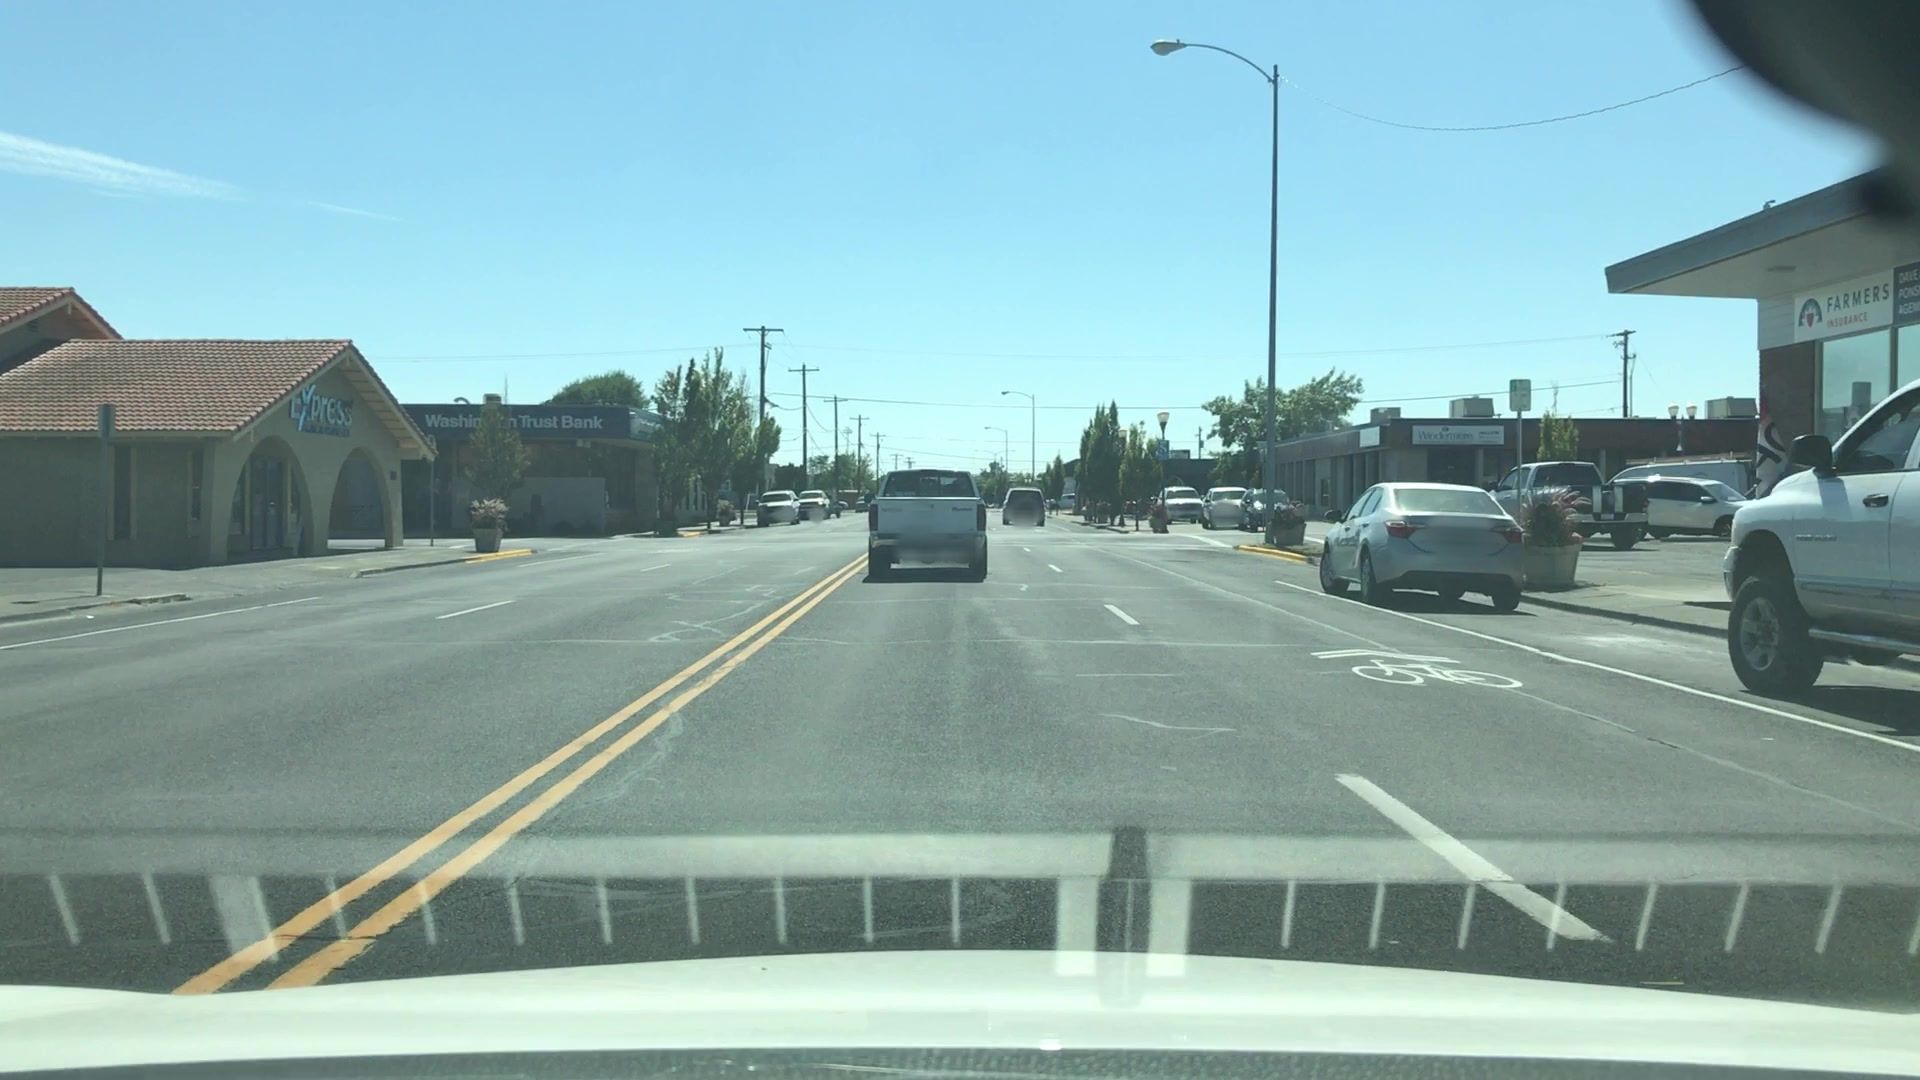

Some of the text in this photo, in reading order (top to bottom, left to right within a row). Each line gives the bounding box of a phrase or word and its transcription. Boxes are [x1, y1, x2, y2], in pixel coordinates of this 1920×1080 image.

[1827, 283, 1889, 312] FARMERS
[1827, 312, 1867, 328] INSURANCE
[425, 414, 603, 430] Washinn Trust Bank
